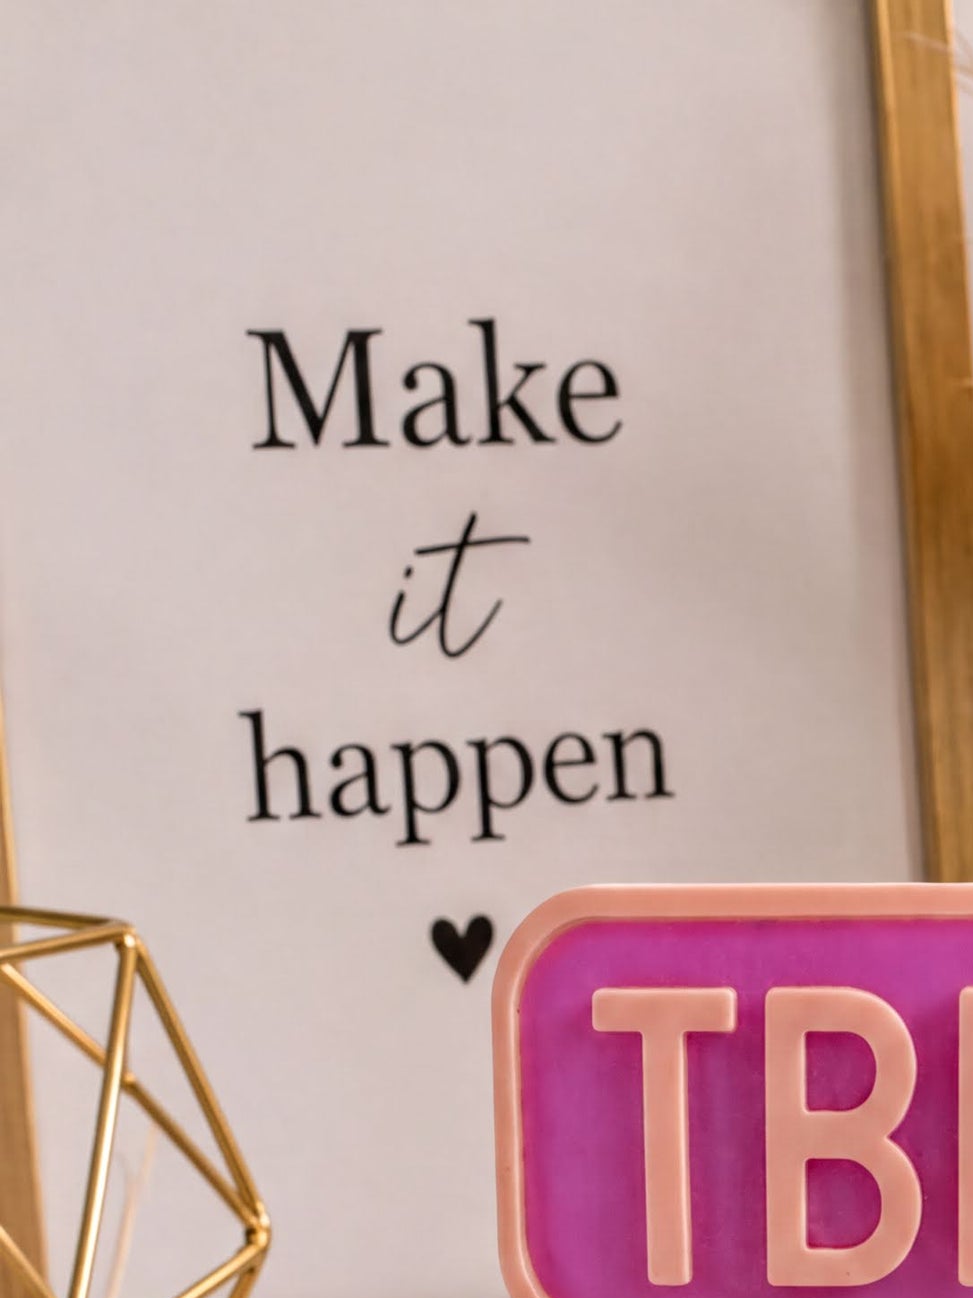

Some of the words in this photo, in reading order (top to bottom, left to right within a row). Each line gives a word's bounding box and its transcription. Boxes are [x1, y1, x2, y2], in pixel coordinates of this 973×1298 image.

[246, 318, 624, 452] Make
[389, 510, 531, 659] it
[238, 708, 676, 848] happen
